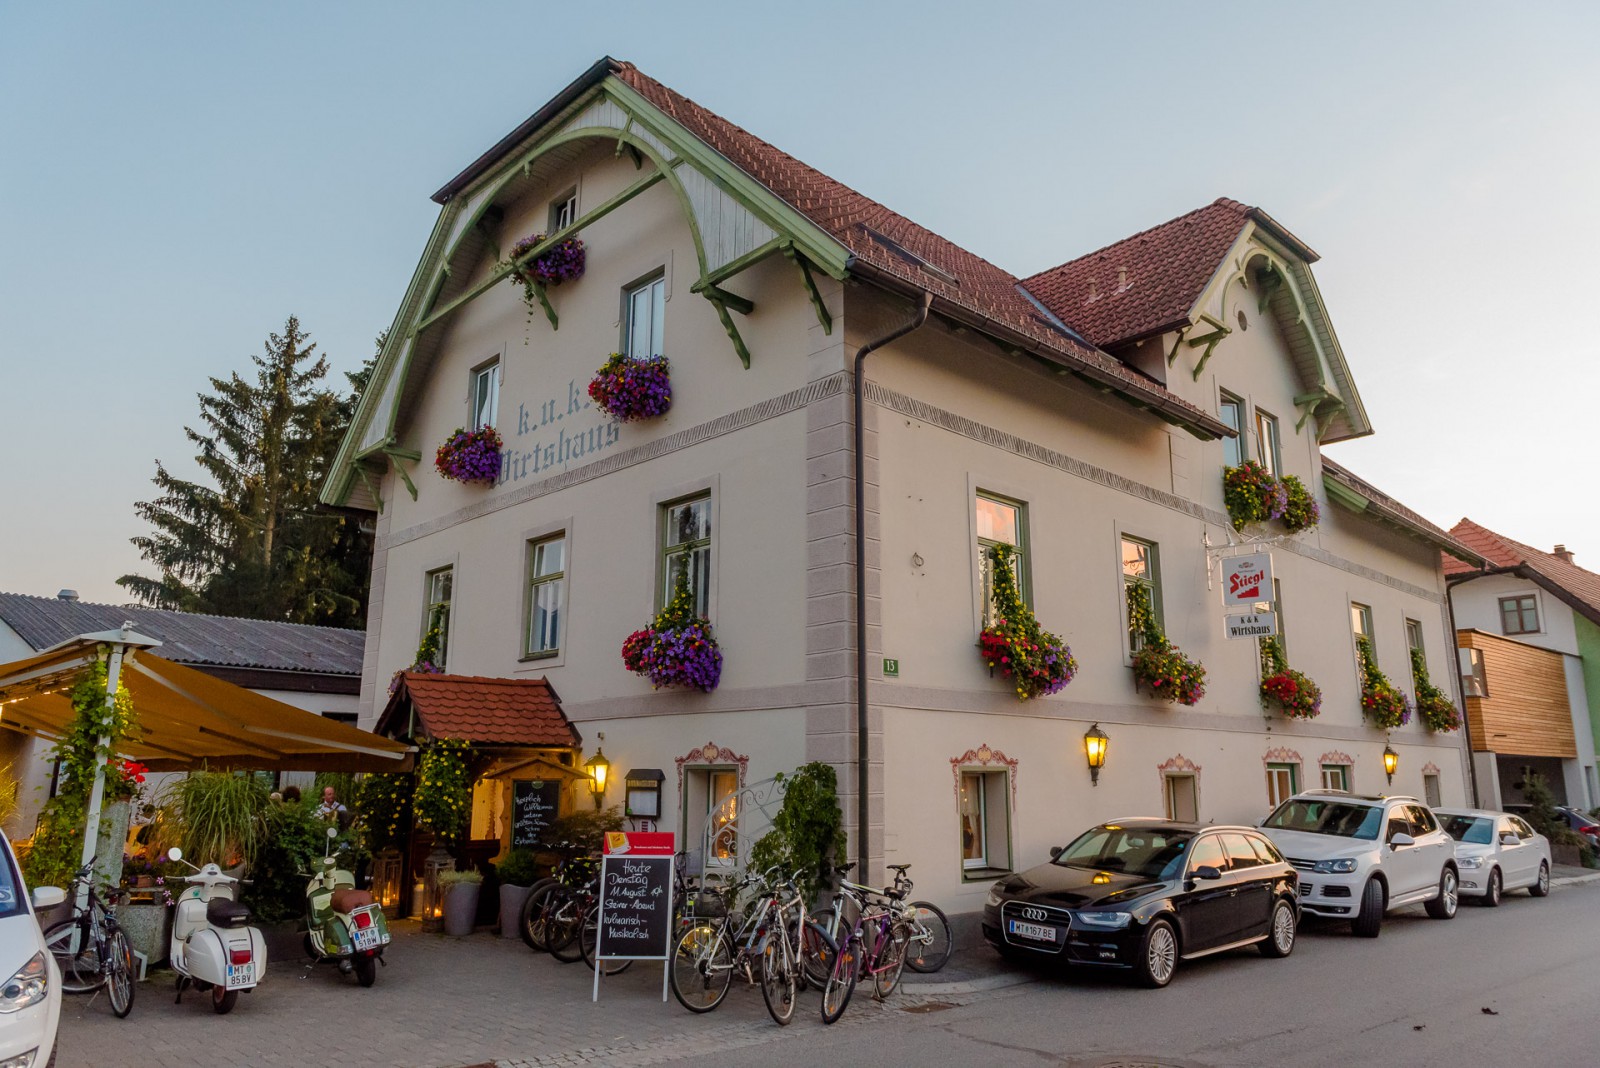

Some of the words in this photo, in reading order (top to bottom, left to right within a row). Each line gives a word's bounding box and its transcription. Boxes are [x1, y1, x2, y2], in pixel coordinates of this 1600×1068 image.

[1229, 569, 1265, 595] Stiegl
[1230, 624, 1271, 636] Wirtshaus
[886, 660, 895, 671] 13
[622, 859, 652, 875] Heute
[607, 872, 648, 889] Dienstag
[1029, 926, 1042, 936] 167
[1043, 928, 1053, 938] BE
[233, 965, 244, 975] MT
